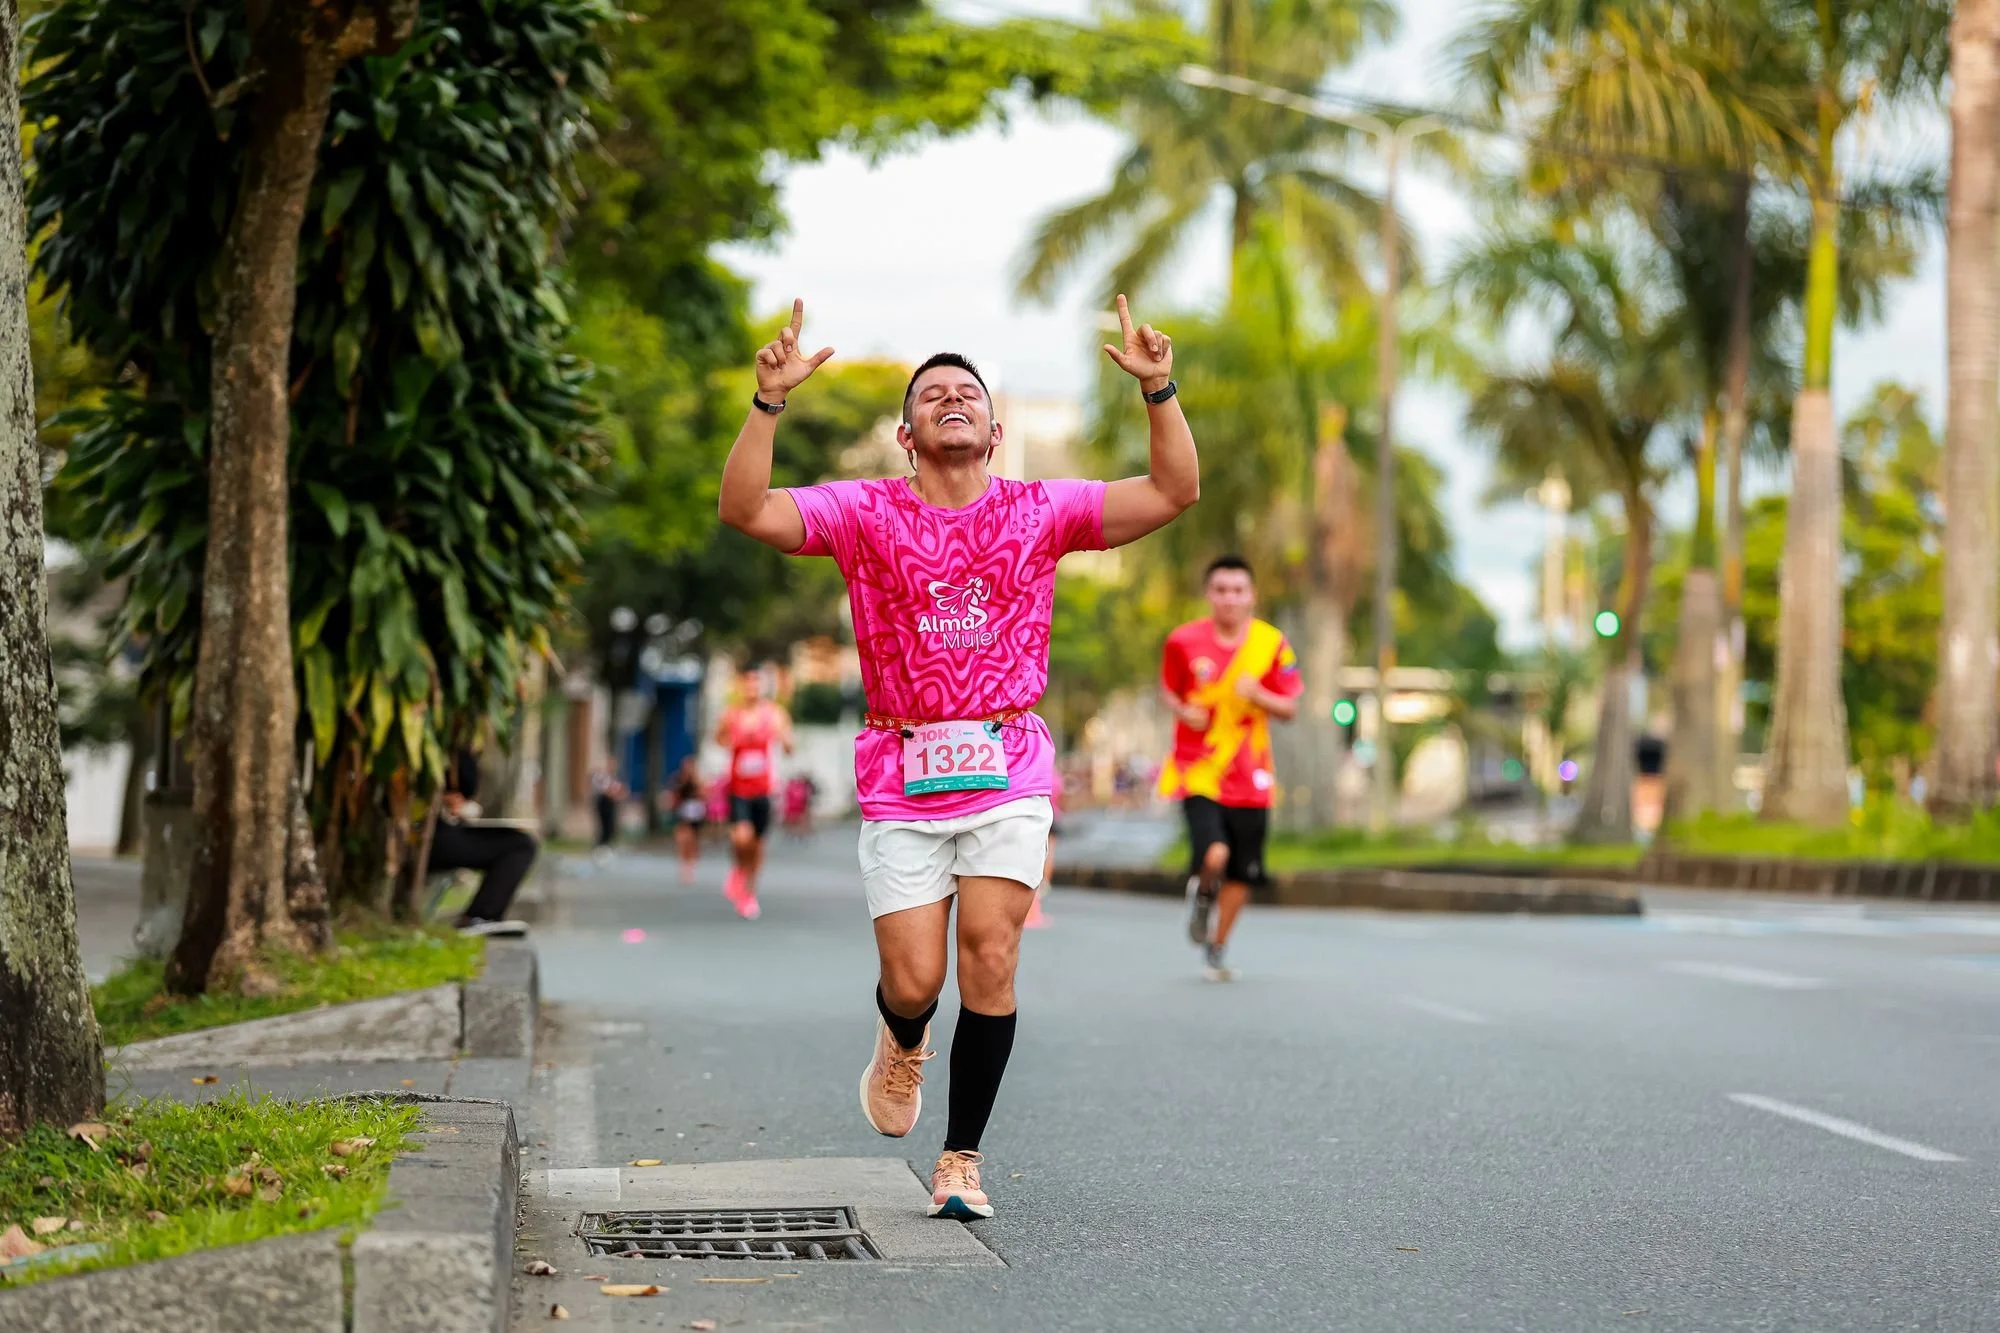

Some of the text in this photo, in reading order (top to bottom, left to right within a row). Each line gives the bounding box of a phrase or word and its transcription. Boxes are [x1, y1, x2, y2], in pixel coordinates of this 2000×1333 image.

[917, 614, 976, 633] Alma
[942, 629, 1001, 653] Mujer
[920, 728, 952, 743] 10K
[916, 743, 997, 776] 1322
